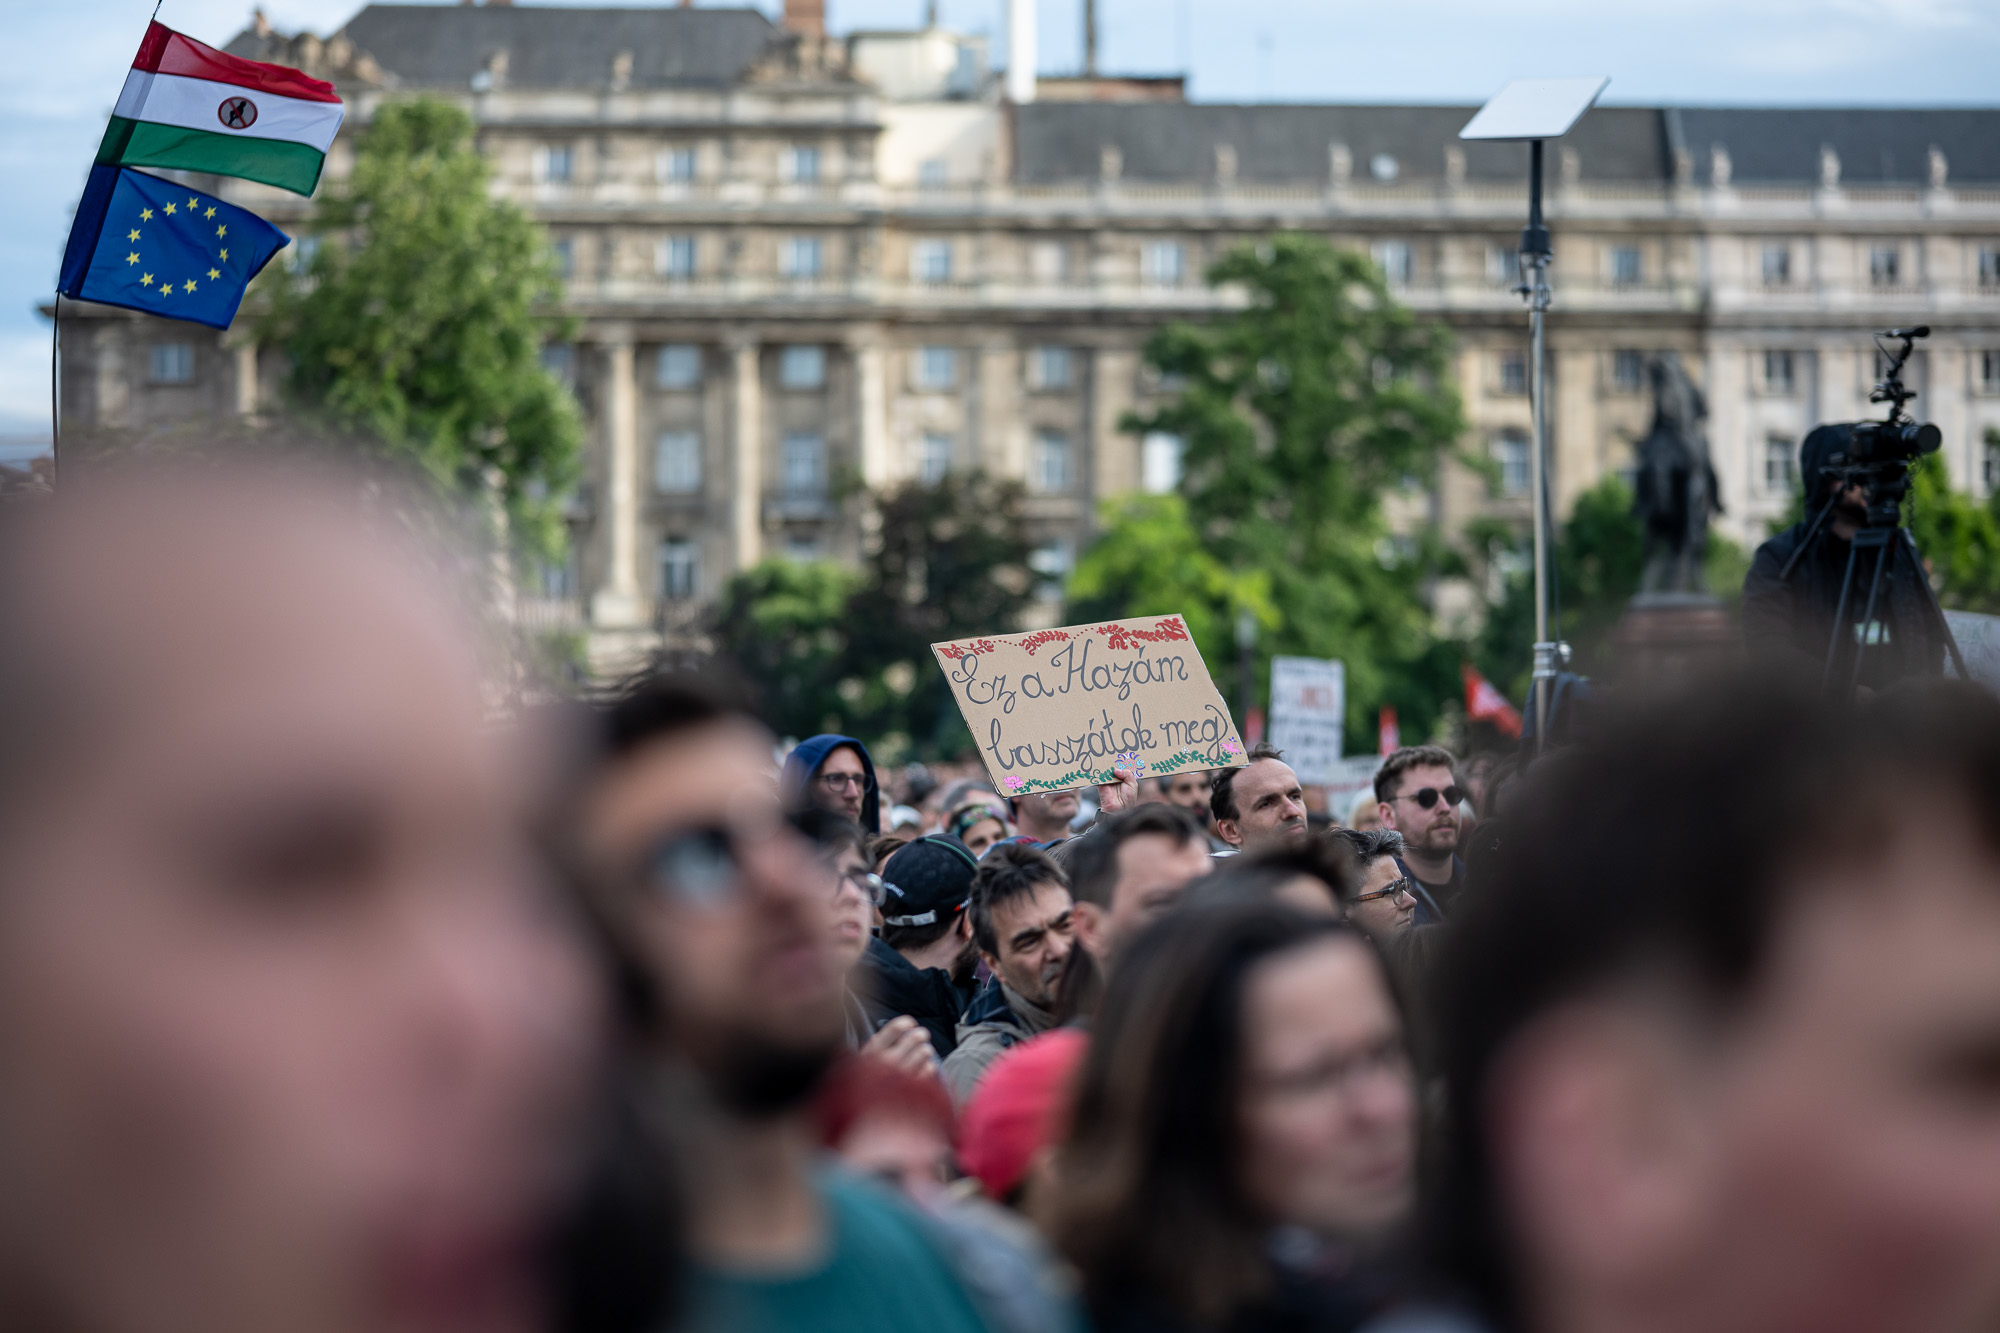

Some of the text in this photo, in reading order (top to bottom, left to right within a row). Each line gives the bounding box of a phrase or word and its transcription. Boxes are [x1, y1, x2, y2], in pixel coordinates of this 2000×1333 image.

[952, 638, 1188, 714] Ez a Hazám
[986, 703, 1157, 772] basszátok
[1160, 704, 1228, 762] meg
